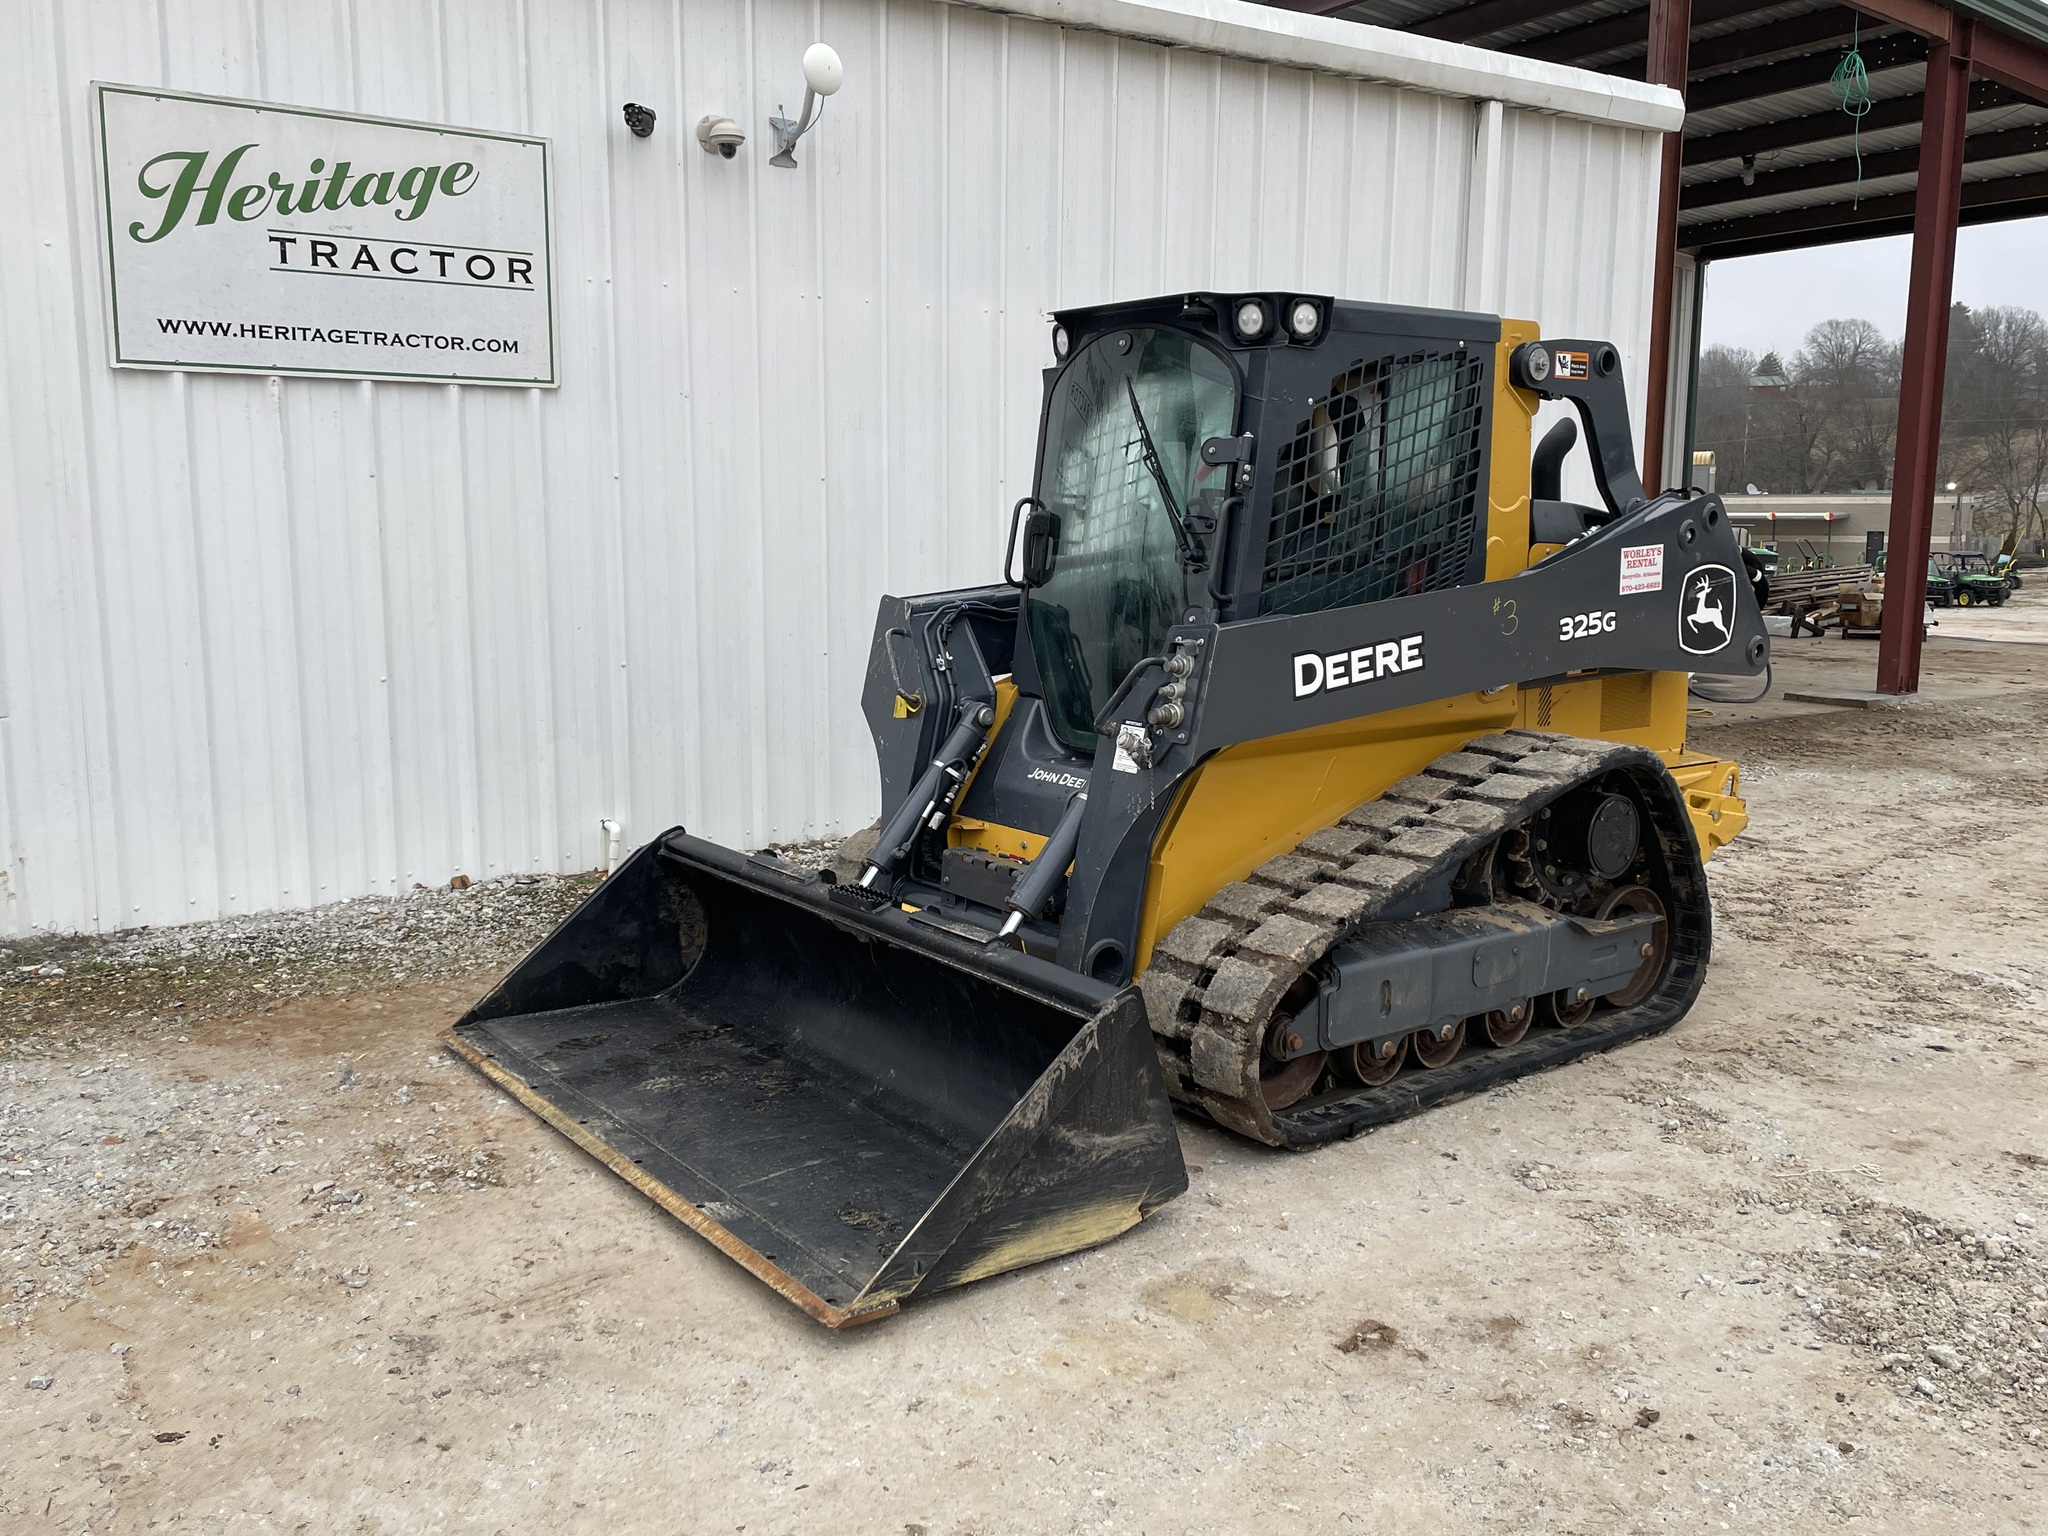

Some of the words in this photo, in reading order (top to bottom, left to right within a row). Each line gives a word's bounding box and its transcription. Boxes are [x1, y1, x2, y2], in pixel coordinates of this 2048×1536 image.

[128, 143, 480, 243] Heritage
[268, 234, 533, 285] TRACTOR
[156, 318, 519, 354] WWW.HERITAGETRACTOR.COM
[1622, 547, 1662, 559] WORLEY'S
[1626, 557, 1658, 569] RENTAL
[1559, 610, 1616, 641] 325G
[1294, 635, 1423, 698] DEERE
[1027, 767, 1060, 785] JOHN
[1058, 773, 1087, 789] DEE
